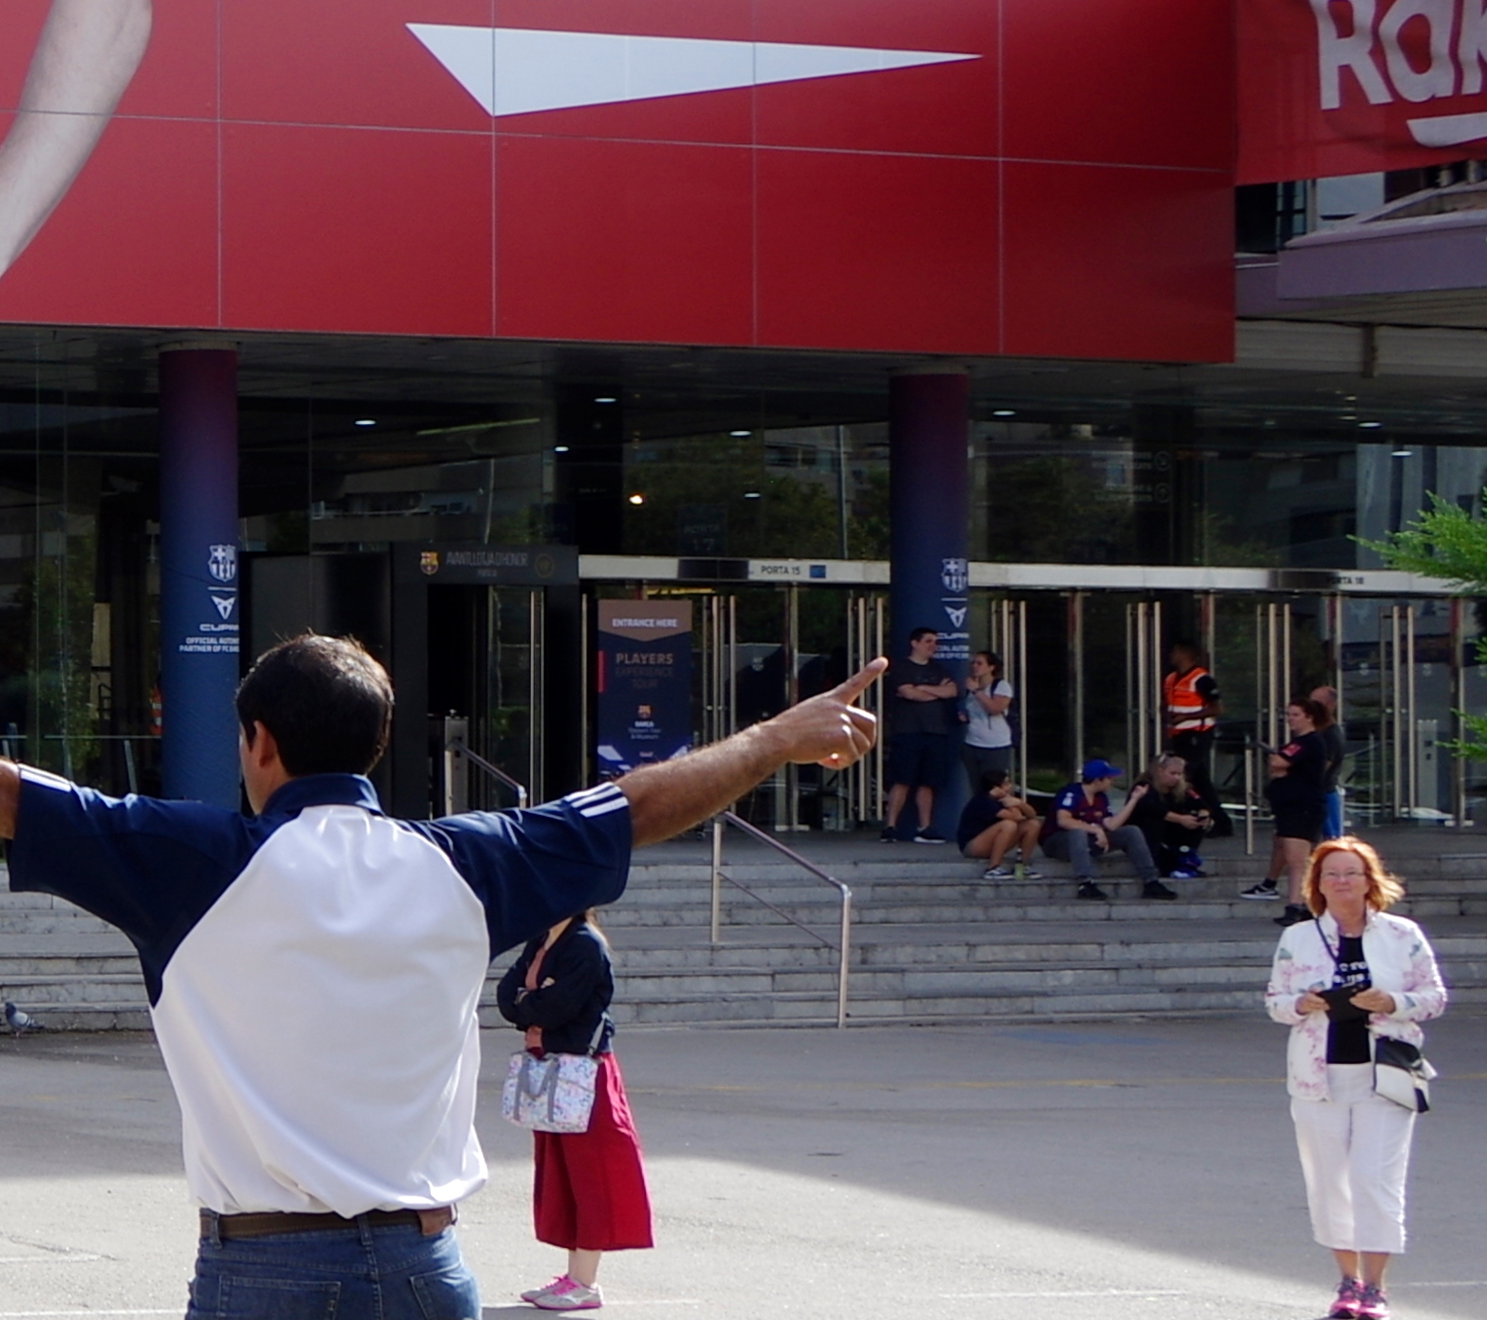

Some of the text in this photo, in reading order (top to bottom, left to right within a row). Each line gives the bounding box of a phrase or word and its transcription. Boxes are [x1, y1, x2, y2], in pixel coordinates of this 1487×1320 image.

[760, 565, 788, 576] PORTA
[612, 618, 678, 628] ENTRANCE HERE
[615, 652, 674, 664] PLAYERS
[615, 667, 674, 677] EXPERIENCE
